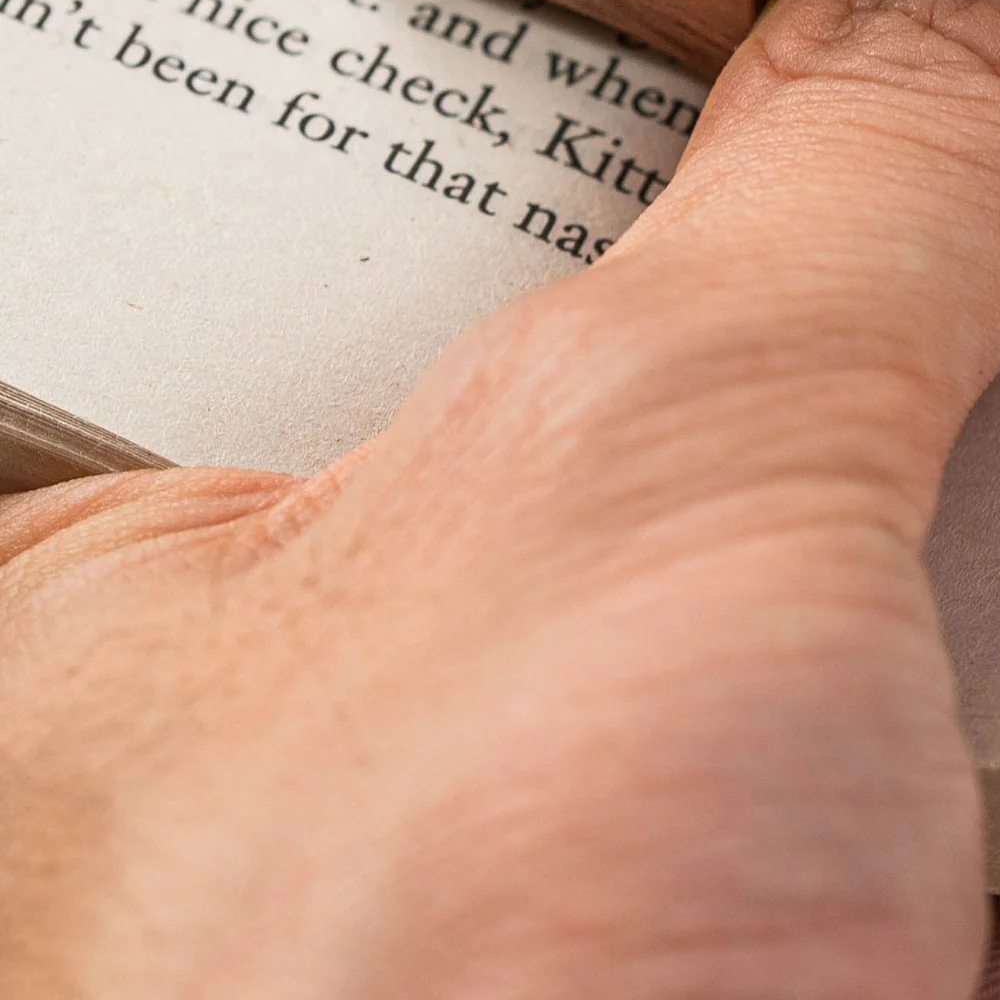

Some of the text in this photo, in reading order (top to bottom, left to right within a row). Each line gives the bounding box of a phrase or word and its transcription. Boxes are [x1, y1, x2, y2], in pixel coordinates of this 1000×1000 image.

[409, 6, 528, 63] and
[115, 24, 255, 112] been
[275, 93, 369, 152] for
[384, 140, 506, 216] that
[330, 47, 509, 146] check,
